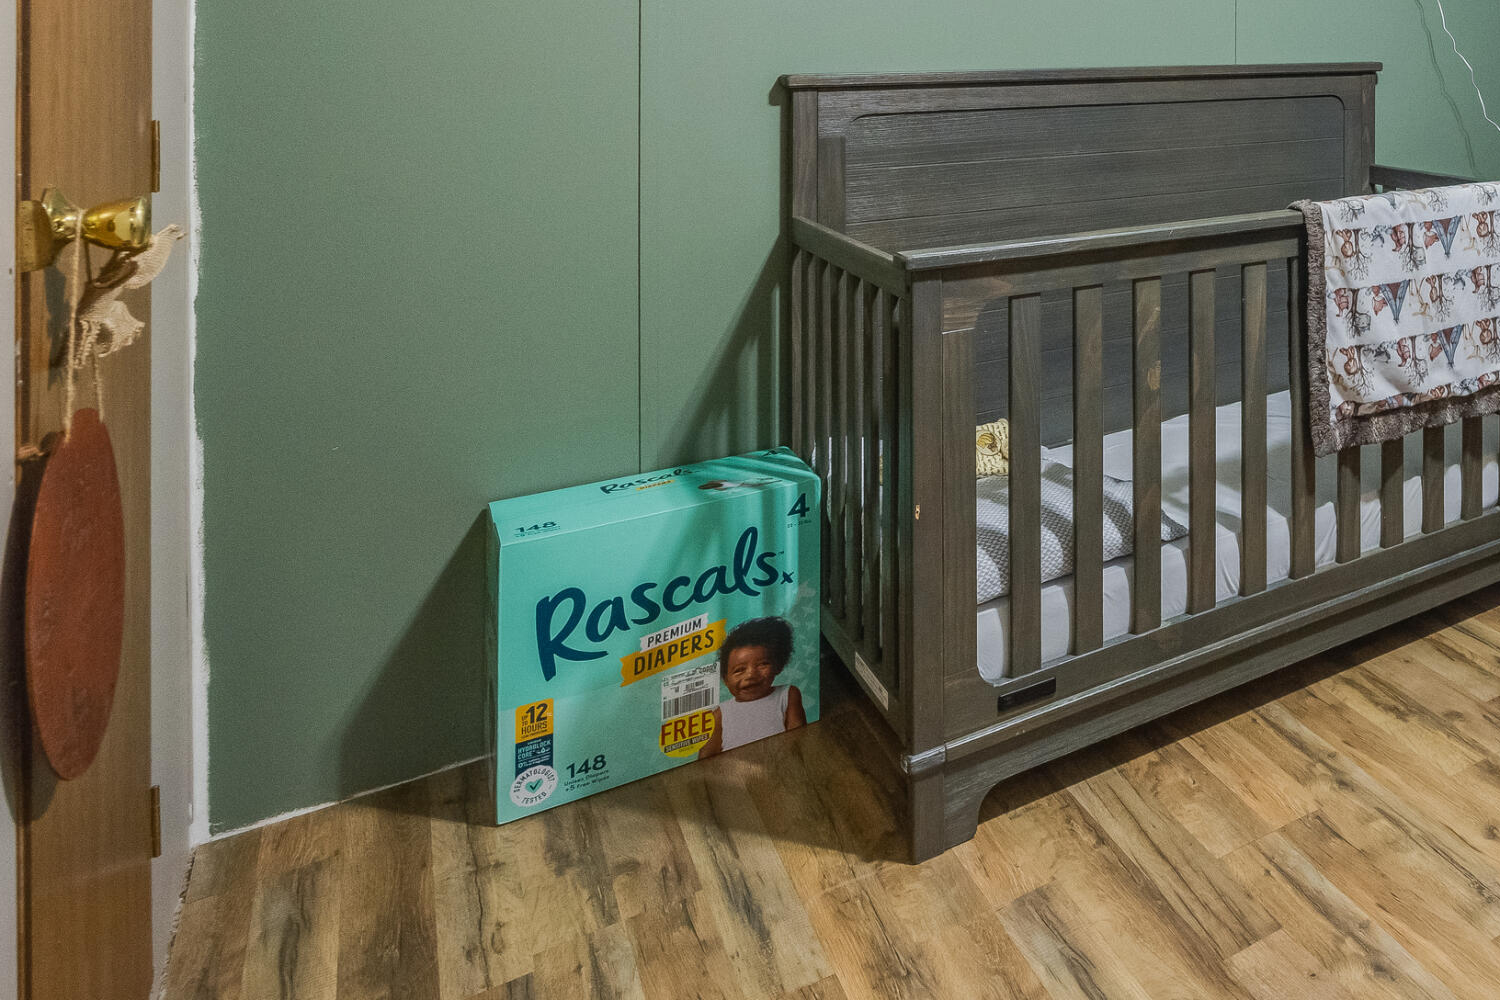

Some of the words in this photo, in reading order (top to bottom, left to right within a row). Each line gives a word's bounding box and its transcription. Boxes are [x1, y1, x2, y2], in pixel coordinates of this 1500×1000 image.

[600, 468, 692, 495] Rascals
[787, 493, 810, 518] 4
[514, 521, 557, 534] 148
[535, 526, 779, 682] Rascals
[646, 618, 702, 648] PREMIUM
[633, 629, 715, 676] DIAPERS
[526, 703, 548, 724] 12
[521, 721, 548, 735] HOURS
[660, 710, 713, 746] FREE
[566, 754, 607, 779] 148
[513, 767, 555, 793] DERMATOLOGIST
[521, 791, 547, 805] TESTED
